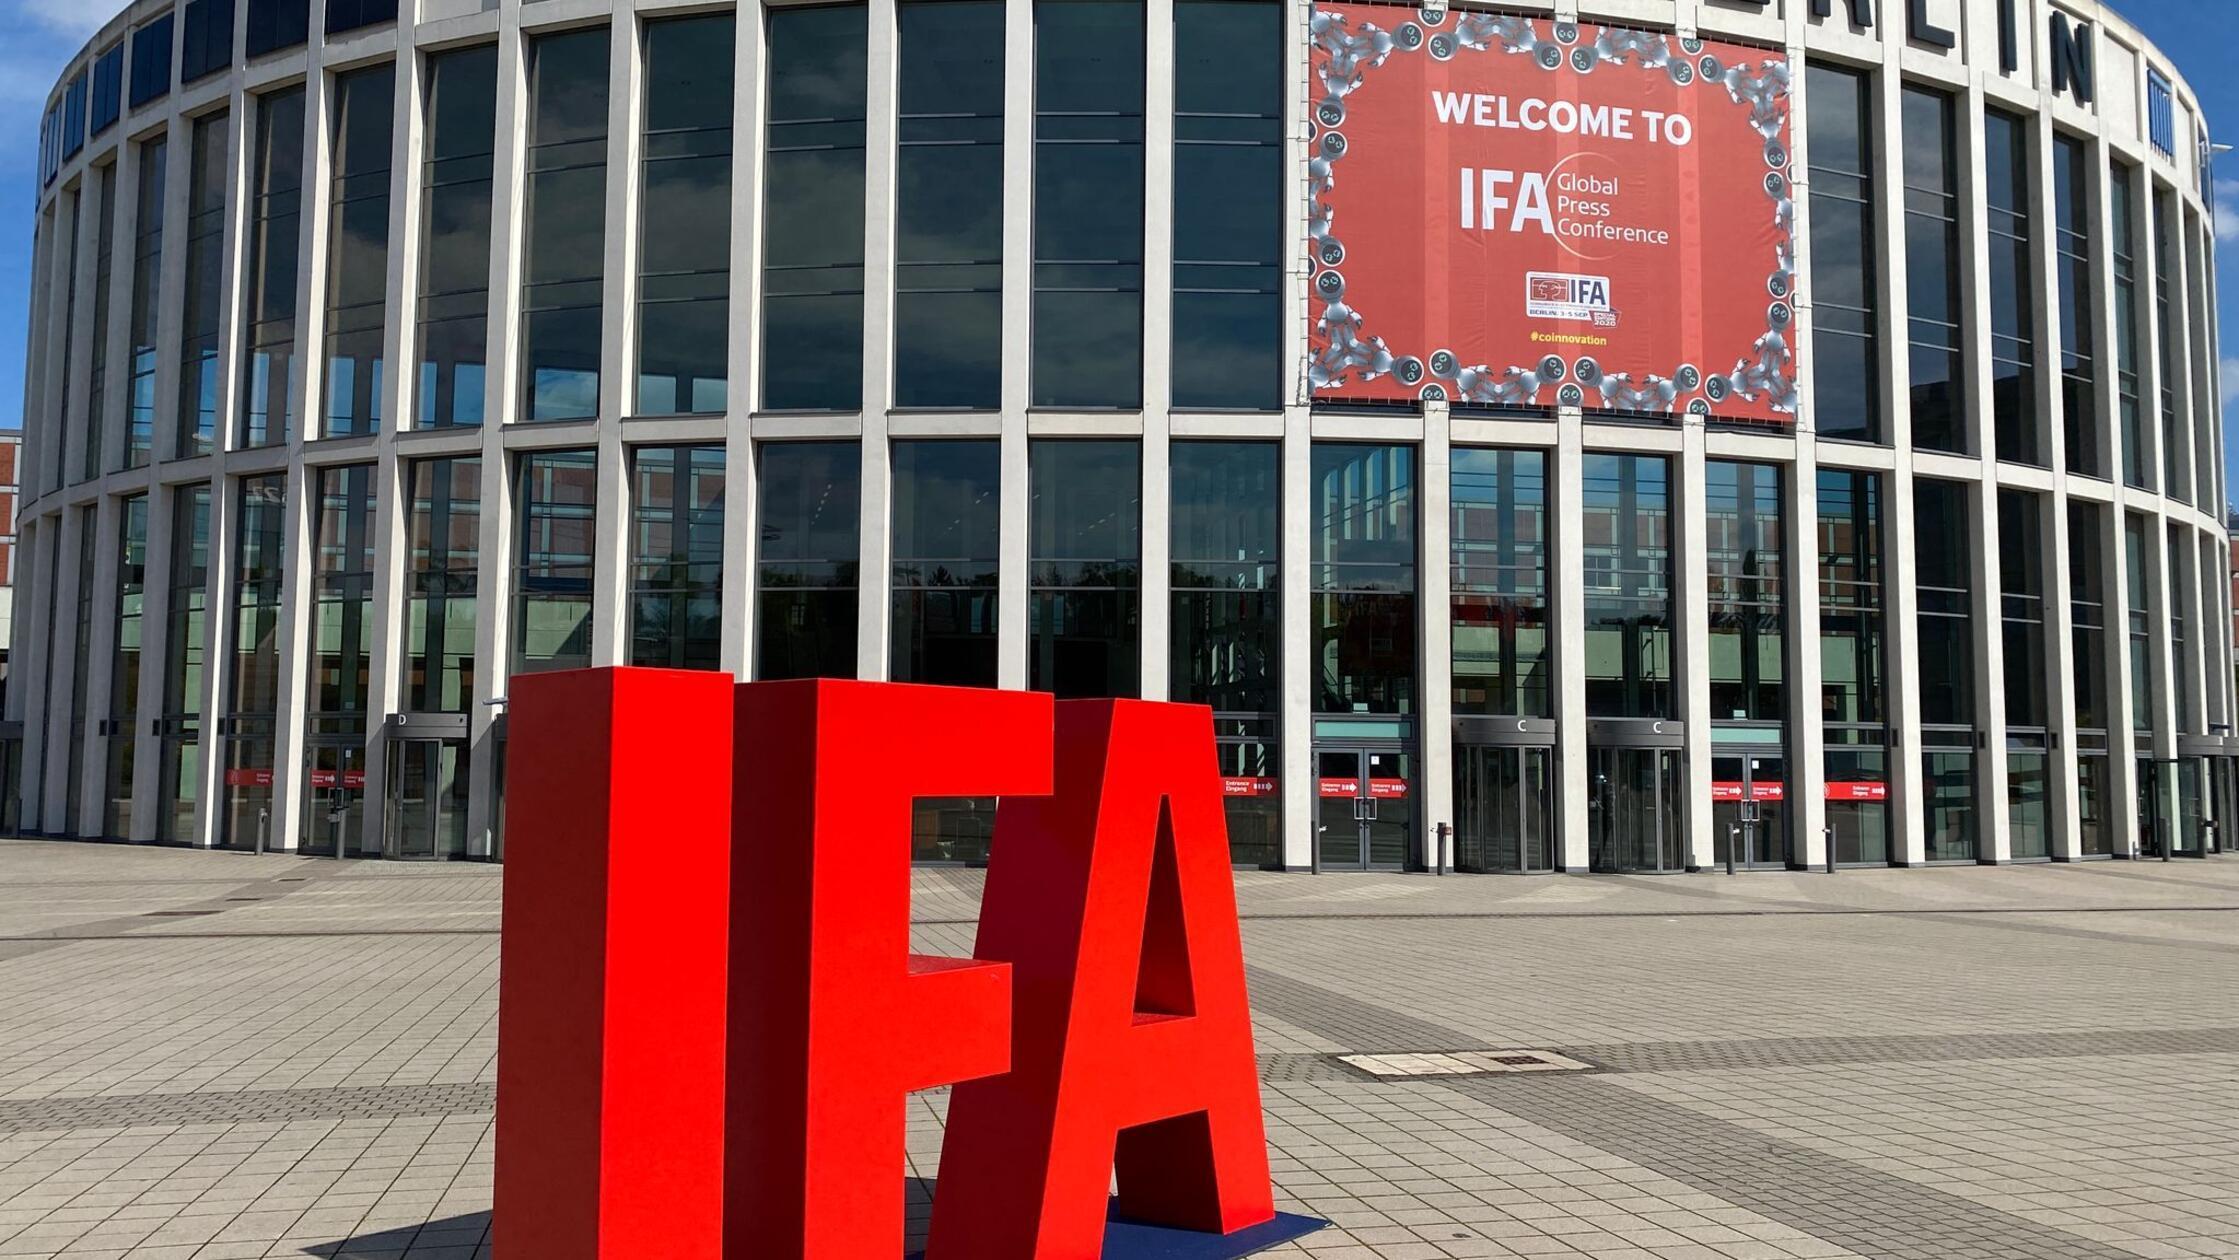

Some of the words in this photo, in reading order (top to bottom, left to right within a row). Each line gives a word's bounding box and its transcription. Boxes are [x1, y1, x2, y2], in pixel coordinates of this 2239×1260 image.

[1432, 91, 1633, 140] WELCOME
[1641, 110, 1692, 146] TO
[1557, 172, 1618, 196] Global
[1461, 167, 1555, 234] IFA
[1557, 196, 1610, 217] Press
[1557, 218, 1669, 245] Conference
[1571, 279, 1606, 305] IFA
[1530, 331, 1607, 345] #coinnovation
[399, 714, 407, 725] D
[1517, 720, 1527, 731] C
[1653, 722, 1662, 733] C
[493, 666, 1275, 1260] IFA
